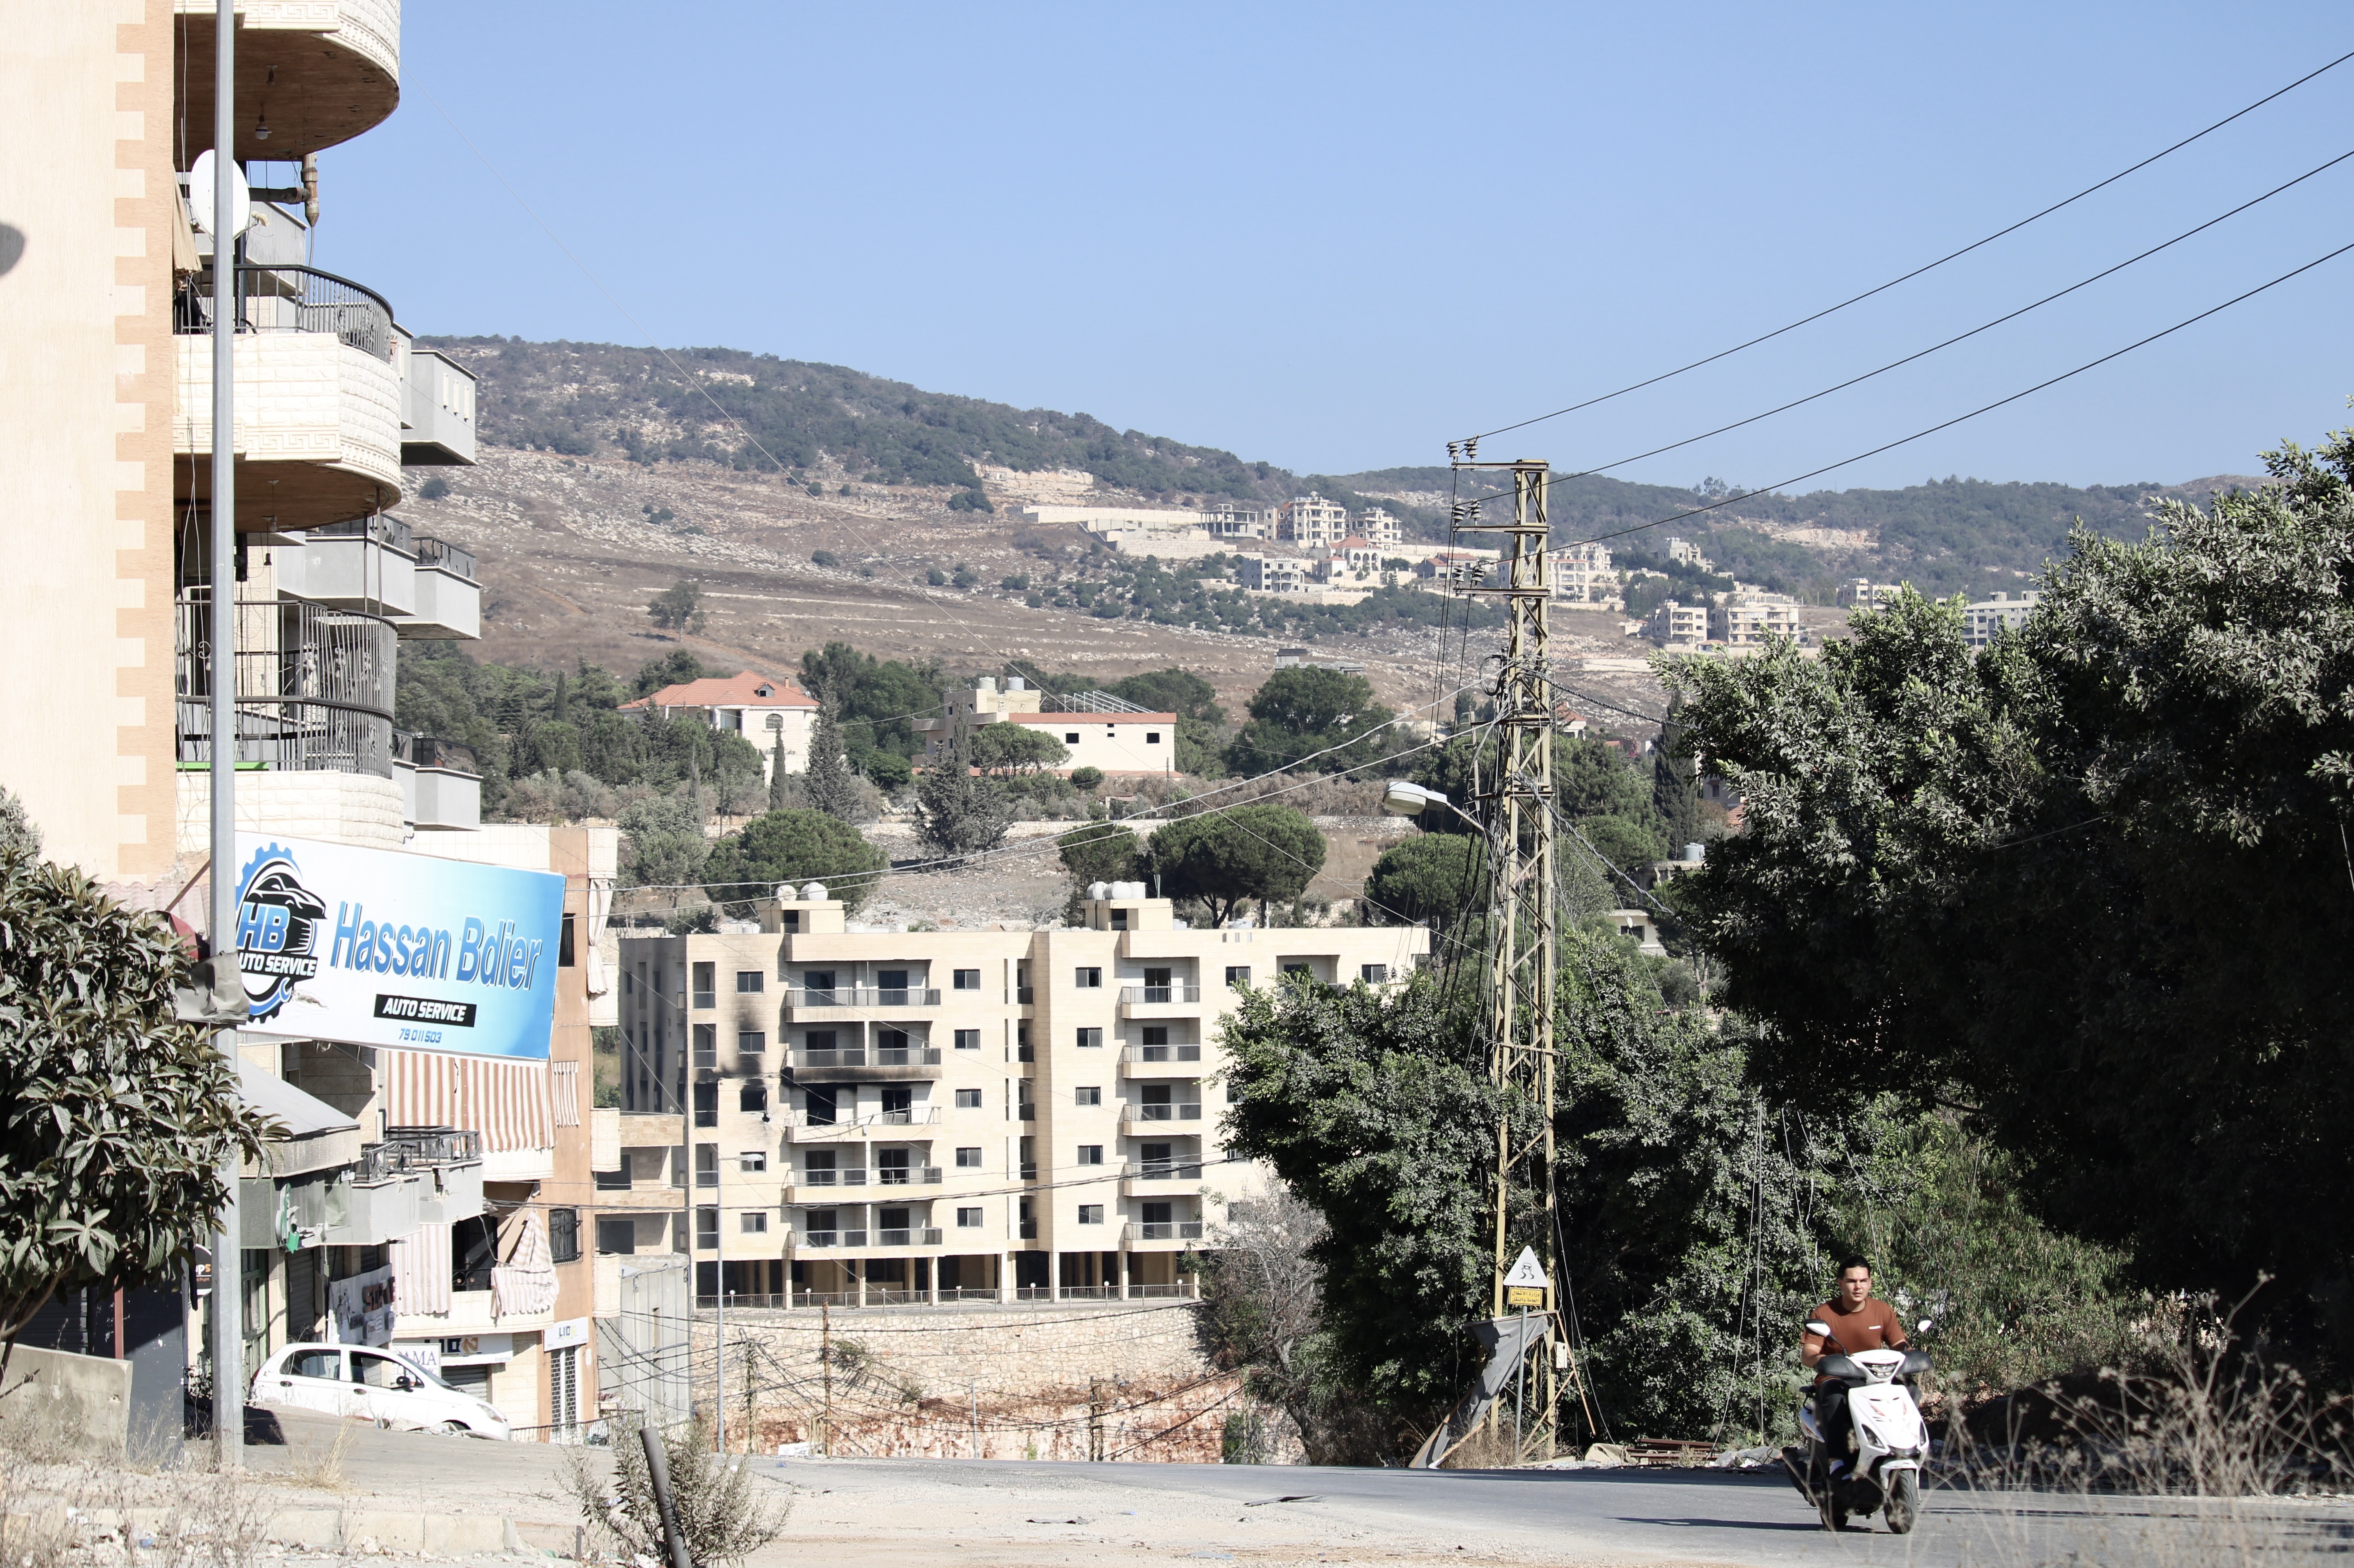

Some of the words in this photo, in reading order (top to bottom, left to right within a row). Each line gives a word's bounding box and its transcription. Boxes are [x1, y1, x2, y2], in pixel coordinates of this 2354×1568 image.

[236, 901, 290, 954] HB
[330, 901, 451, 981] Hassan
[456, 915, 542, 991] Bdier
[239, 952, 265, 971] UTO
[265, 955, 317, 976] SERVICE
[382, 997, 418, 1017] AUTO
[418, 1001, 467, 1022] SERVICE
